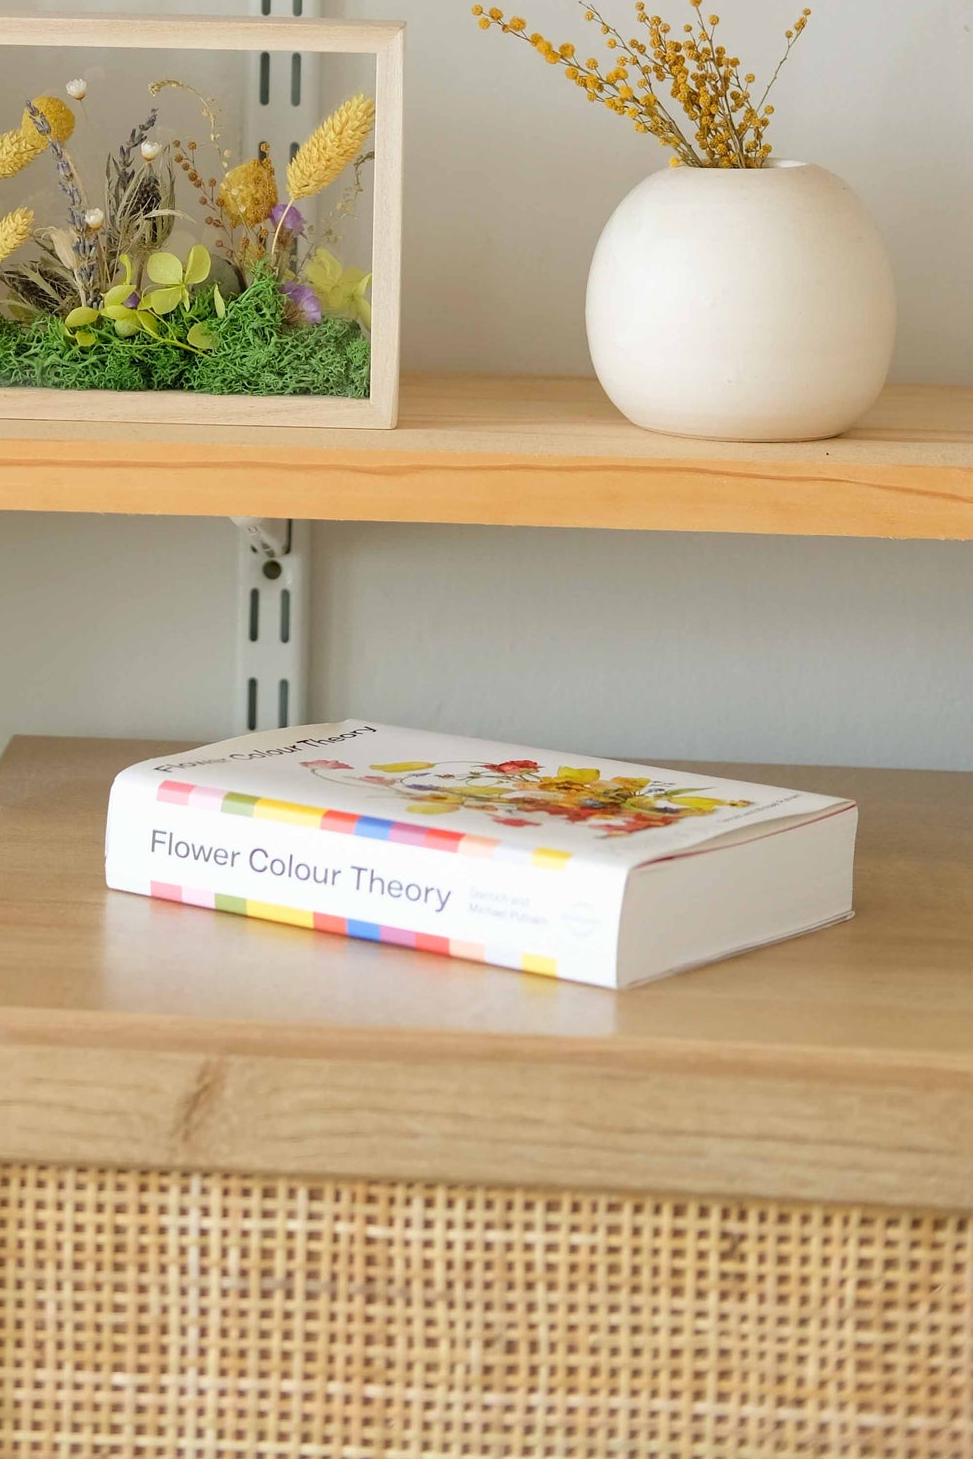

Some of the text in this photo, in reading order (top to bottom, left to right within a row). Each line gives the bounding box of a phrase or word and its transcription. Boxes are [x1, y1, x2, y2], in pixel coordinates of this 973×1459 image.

[153, 724, 378, 775] Flower Colour Theory
[150, 828, 452, 913] Flower Colour Theory
